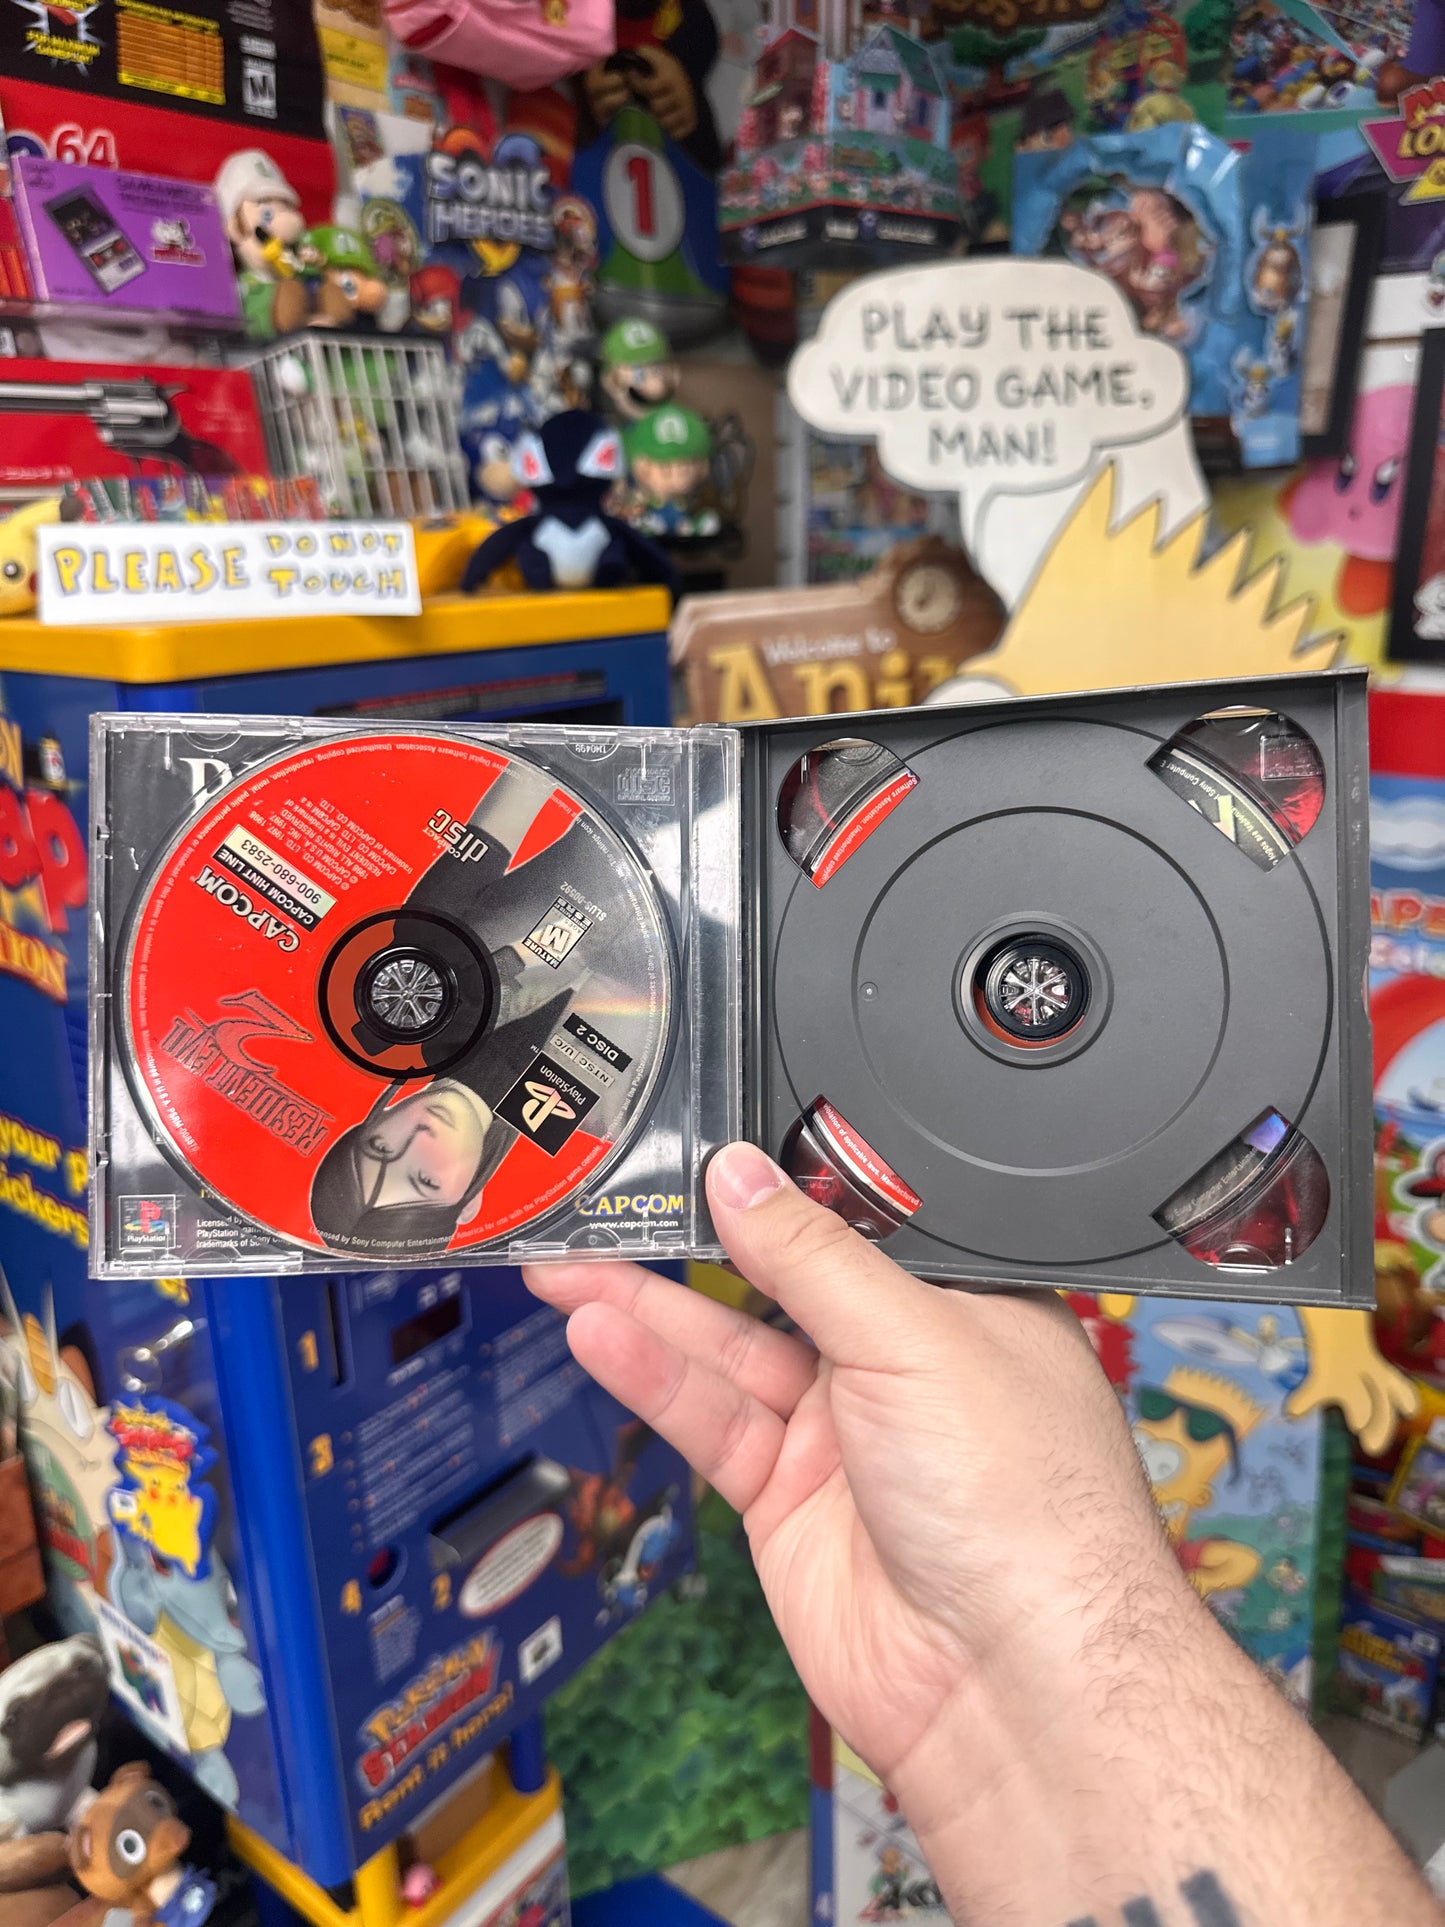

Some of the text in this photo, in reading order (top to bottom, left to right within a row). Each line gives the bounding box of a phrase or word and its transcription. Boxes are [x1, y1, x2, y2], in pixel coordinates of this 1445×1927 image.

[429, 152, 551, 212] SONIC
[862, 304, 1113, 351] PLAY THE
[830, 364, 981, 412] VIDEO
[927, 422, 1056, 467] MAN!
[53, 532, 403, 594] PLEASE DO NOT
[267, 568, 406, 599] TOUCH
[345, 743, 391, 756] Unauthorized
[436, 746, 467, 760] Software
[467, 752, 491, 767] Digital
[892, 778, 918, 798] Software
[1167, 763, 1200, 787] Computer
[228, 789, 250, 809] public
[1199, 781, 1218, 801] Sony
[194, 804, 232, 841] performance
[295, 806, 325, 832] trademark
[311, 805, 342, 831] CAPCOM
[579, 820, 594, 835] icon
[314, 834, 341, 857] RIGHTS
[334, 837, 352, 853] EVIL
[346, 820, 377, 846] CAPCOM
[421, 826, 462, 858] COMPACT
[834, 824, 863, 862] Unauthorized
[240, 837, 322, 905] 900-680-2583
[312, 859, 342, 885] CAPCOM
[321, 853, 351, 879] CAPCOM
[339, 853, 354, 868] ALL
[350, 849, 383, 877] RESIDENT
[368, 850, 397, 875] CAPCOM
[381, 847, 414, 875] trademark
[218, 848, 315, 926] CAPCOM HINT LINE
[193, 864, 303, 956] CAPCOM
[524, 938, 559, 967] MATURE
[539, 924, 573, 954] M
[646, 953, 657, 971] Sony
[215, 990, 316, 1076] 2
[575, 1024, 619, 1061] DISC 2
[554, 1038, 609, 1082] NTSC U/C
[160, 1015, 328, 1156] RESIDENT EVIL
[540, 1064, 586, 1105] PlayStation
[823, 1104, 840, 1130] violation
[843, 1134, 869, 1163] applicable
[880, 1173, 921, 1206] Manufactured
[565, 1165, 585, 1183] game
[534, 1178, 570, 1208] PlayStation
[575, 1194, 684, 1216] CAPCOM
[197, 1229, 239, 1238] PlayStation
[197, 1240, 239, 1248] trademarks
[241, 1239, 248, 1247] of
[351, 1235, 369, 1246] Sony
[371, 1238, 405, 1248] Computer
[310, 1433, 334, 1478] 3
